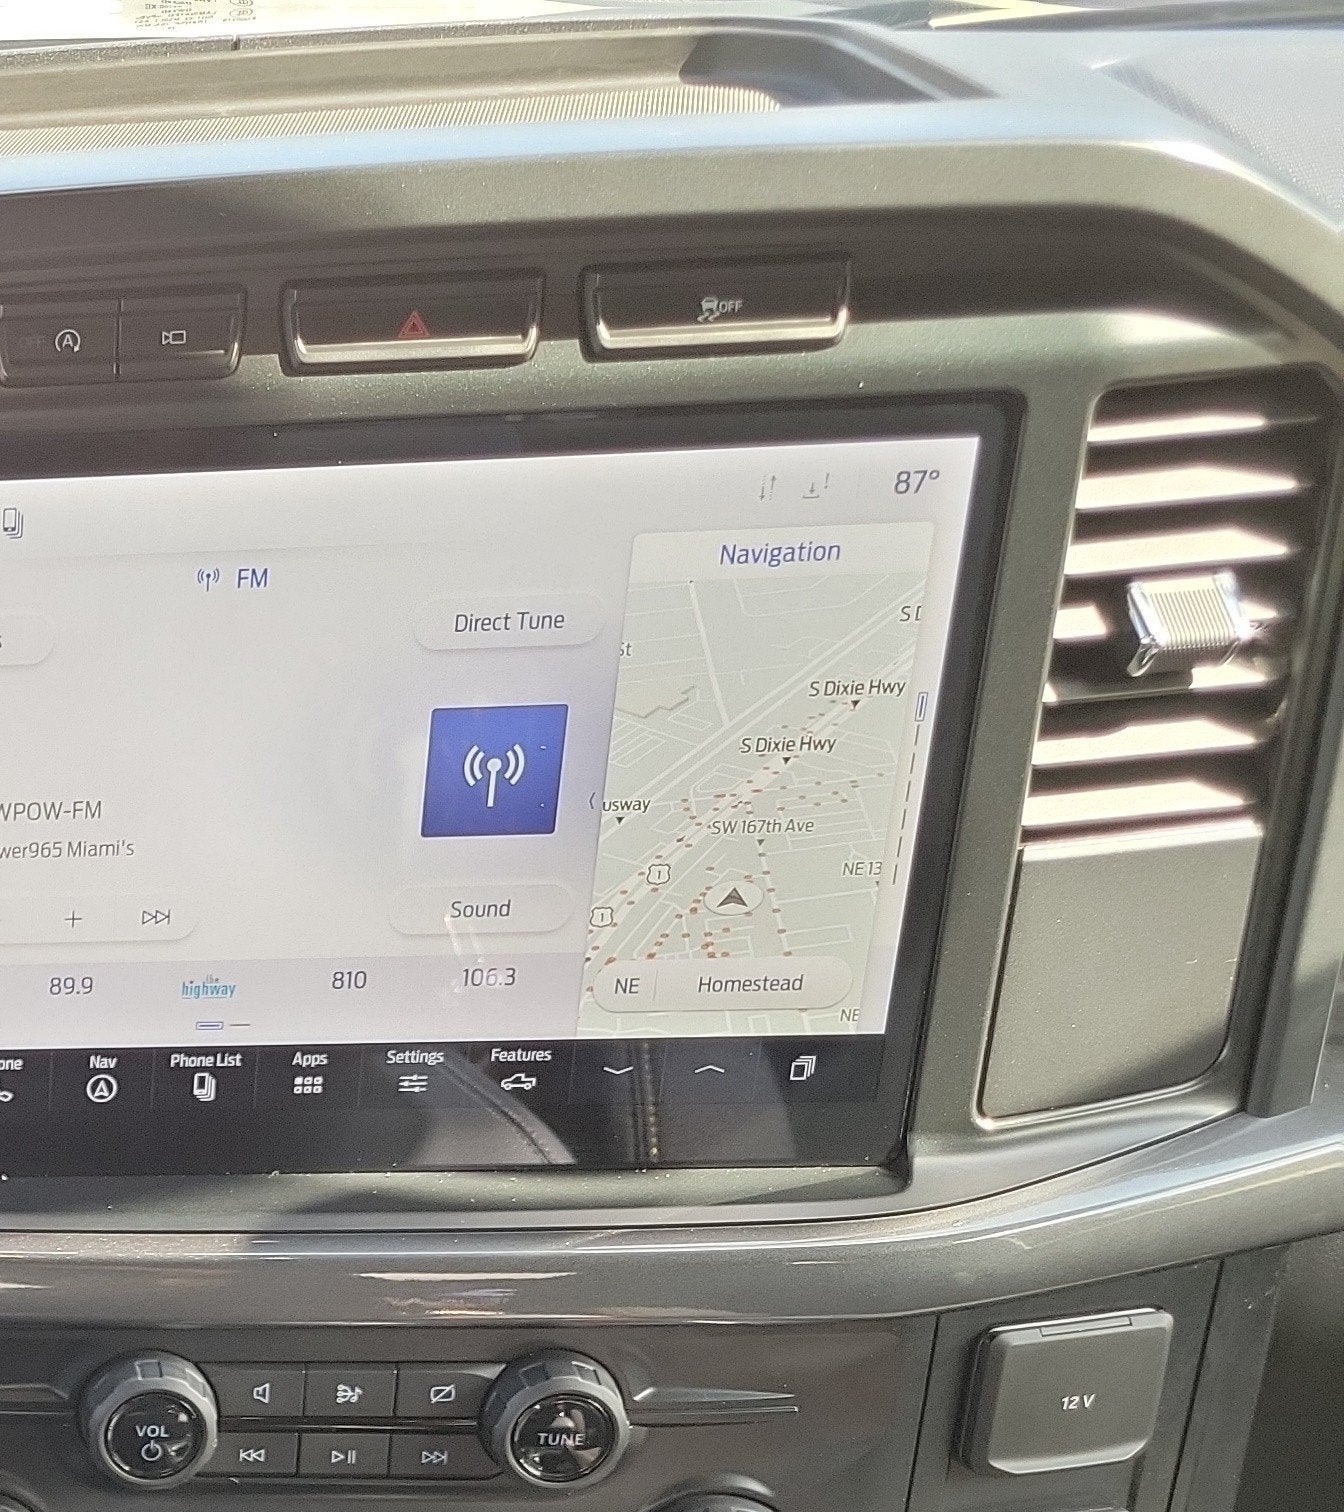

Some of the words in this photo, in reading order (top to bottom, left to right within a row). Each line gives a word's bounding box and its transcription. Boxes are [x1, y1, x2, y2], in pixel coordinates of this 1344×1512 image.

[718, 299, 743, 313] OFF
[894, 469, 940, 495] 87°
[720, 542, 841, 568] Navigation
[237, 567, 268, 589] FM
[454, 613, 511, 633] Direct
[516, 611, 565, 630] Tune
[899, 605, 911, 622] S
[808, 680, 820, 698] S
[823, 680, 865, 697] Dixie
[868, 679, 906, 697] Hwy
[740, 737, 752, 754] S
[755, 737, 795, 754] Dixie
[799, 736, 837, 754] Hwy
[602, 799, 651, 814] usway
[711, 818, 738, 834] SW
[742, 817, 782, 833] 167th
[784, 817, 815, 833] Ave
[67, 839, 135, 857] Miami's
[842, 861, 865, 876] NE
[451, 899, 512, 918] Sound
[331, 970, 367, 990] 810
[463, 967, 516, 987] 106.3
[614, 977, 640, 994] NE
[698, 974, 804, 993] Homestead
[49, 976, 94, 996] 89.9
[181, 980, 237, 999] highway
[89, 1054, 118, 1069] Nav
[170, 1053, 215, 1068] Phone
[215, 1052, 242, 1067] List
[291, 1051, 328, 1068] Apps
[386, 1049, 445, 1066] Settings
[490, 1047, 552, 1062] Features
[1062, 1395, 1080, 1410] 12
[1083, 1393, 1096, 1408] V
[135, 1424, 169, 1439] VOL
[537, 1432, 585, 1447] TUNE
